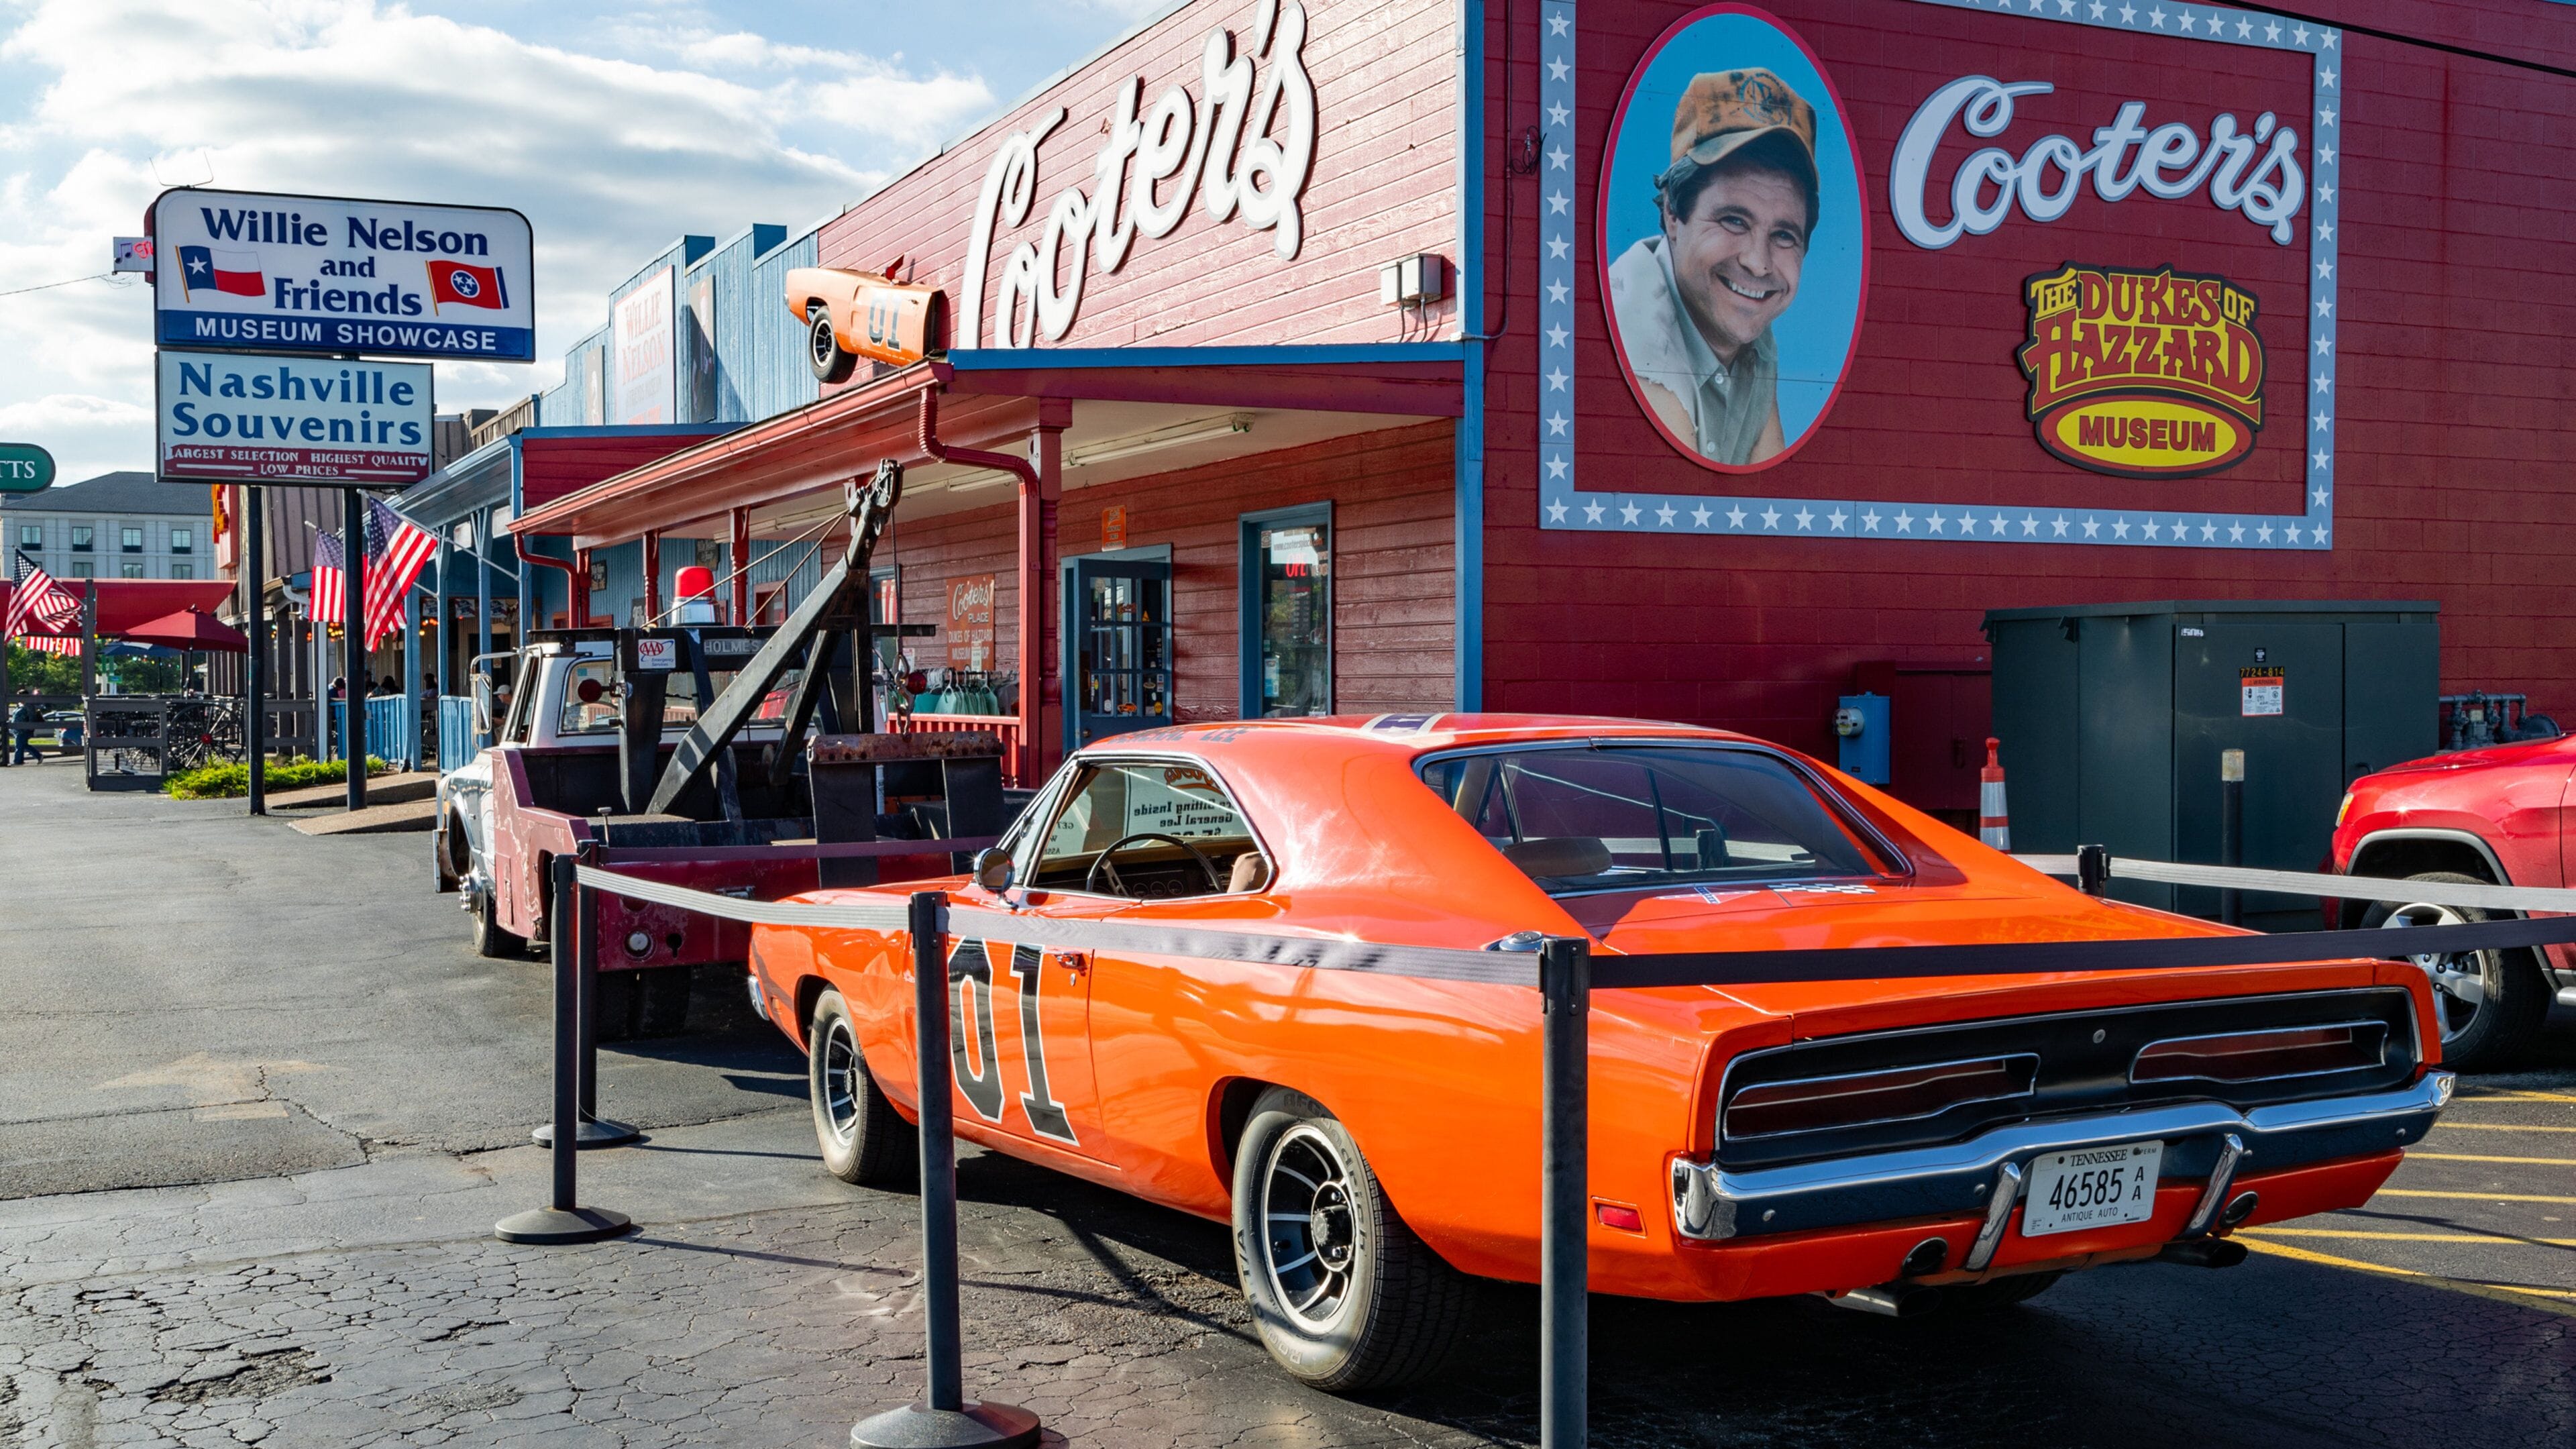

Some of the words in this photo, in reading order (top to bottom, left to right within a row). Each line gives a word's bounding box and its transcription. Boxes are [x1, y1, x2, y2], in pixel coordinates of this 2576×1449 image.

[957, 0, 1316, 349] Cooter's
[1890, 74, 2305, 250] Cooter's
[200, 207, 327, 246] Willie
[347, 217, 488, 256] Nelson
[320, 256, 376, 278] and
[274, 277, 423, 316] Friends
[625, 288, 662, 341] WILLIE
[2031, 268, 2077, 319] THE
[2078, 270, 2221, 327] DUKES
[2224, 287, 2255, 326] OF
[195, 317, 321, 341] MUSEUM
[337, 323, 496, 350] SHOWCASE
[622, 330, 665, 385] NELSON
[2023, 308, 2263, 415] HAZZARD
[178, 362, 414, 405] Nashville
[172, 402, 422, 445] Souvenirs
[2079, 415, 2216, 451] MUSEUM
[231, 450, 299, 462] SELECTION
[311, 453, 366, 464] HIGHEST
[260, 464, 288, 475] LOW
[295, 466, 338, 476] PRICES
[968, 612, 989, 623] PLACE
[640, 641, 661, 655] AAA
[704, 641, 759, 653] HOLMES
[2241, 667, 2284, 677] 7724-814
[948, 936, 1080, 1147] 01
[2070, 1148, 2128, 1167] TENNESSEE
[2049, 1167, 2125, 1210] 46585
[2135, 1166, 2144, 1181] A
[2132, 1185, 2141, 1201] A
[2061, 1210, 2093, 1222] ANTIQUE
[2098, 1208, 2118, 1218] AUTO
